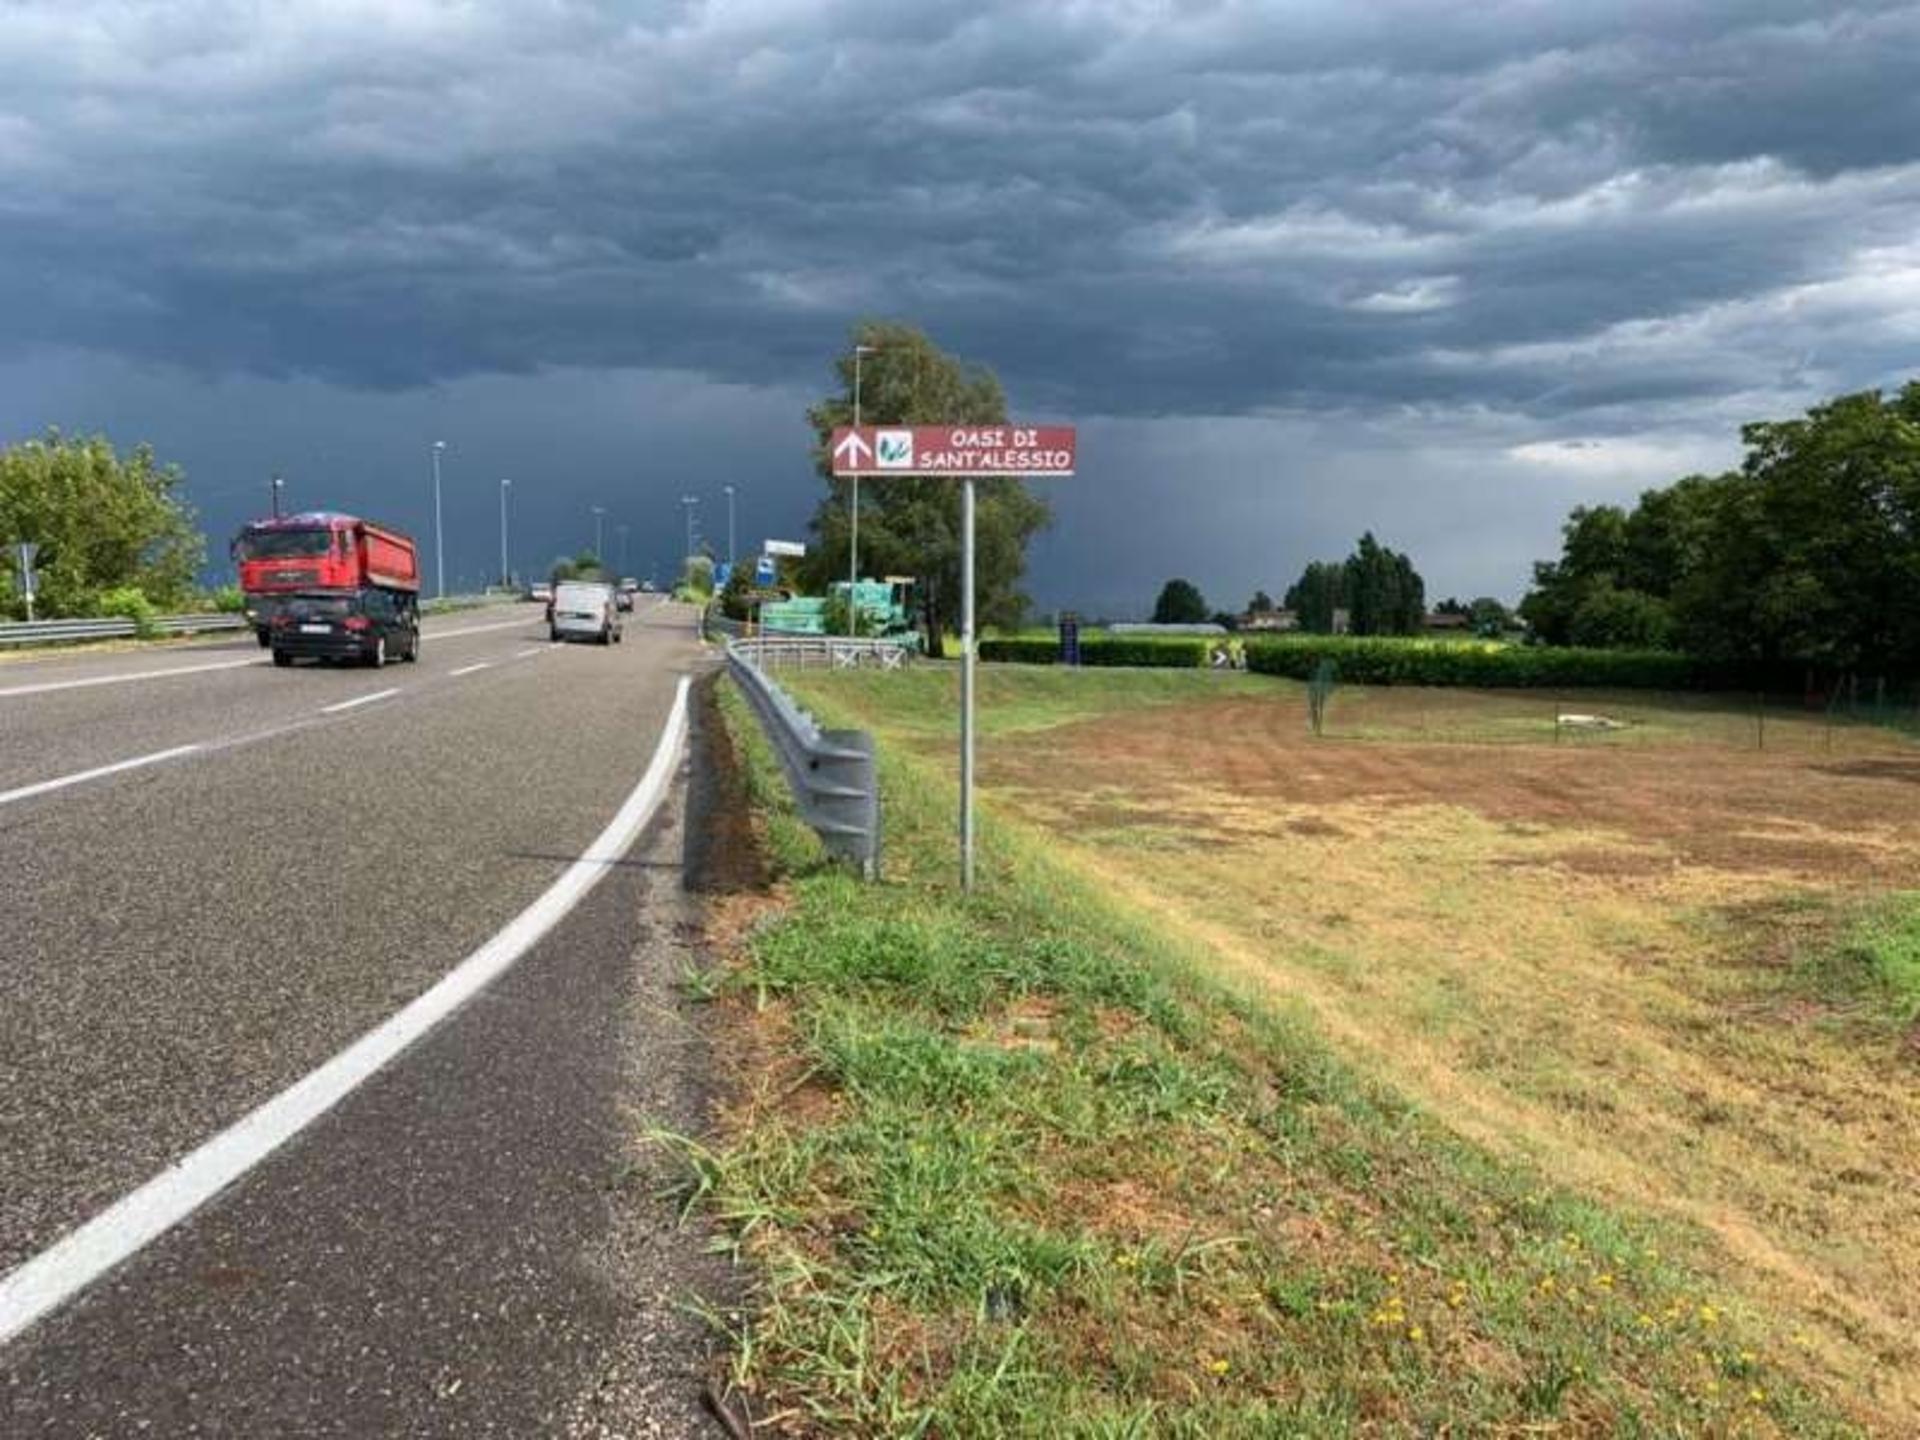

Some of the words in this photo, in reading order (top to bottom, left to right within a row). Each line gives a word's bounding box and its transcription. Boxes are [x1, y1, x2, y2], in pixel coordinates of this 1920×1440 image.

[952, 430, 1004, 447] OASI
[1014, 430, 1038, 447] DI
[920, 451, 1070, 468] SANT'ALESSIO
